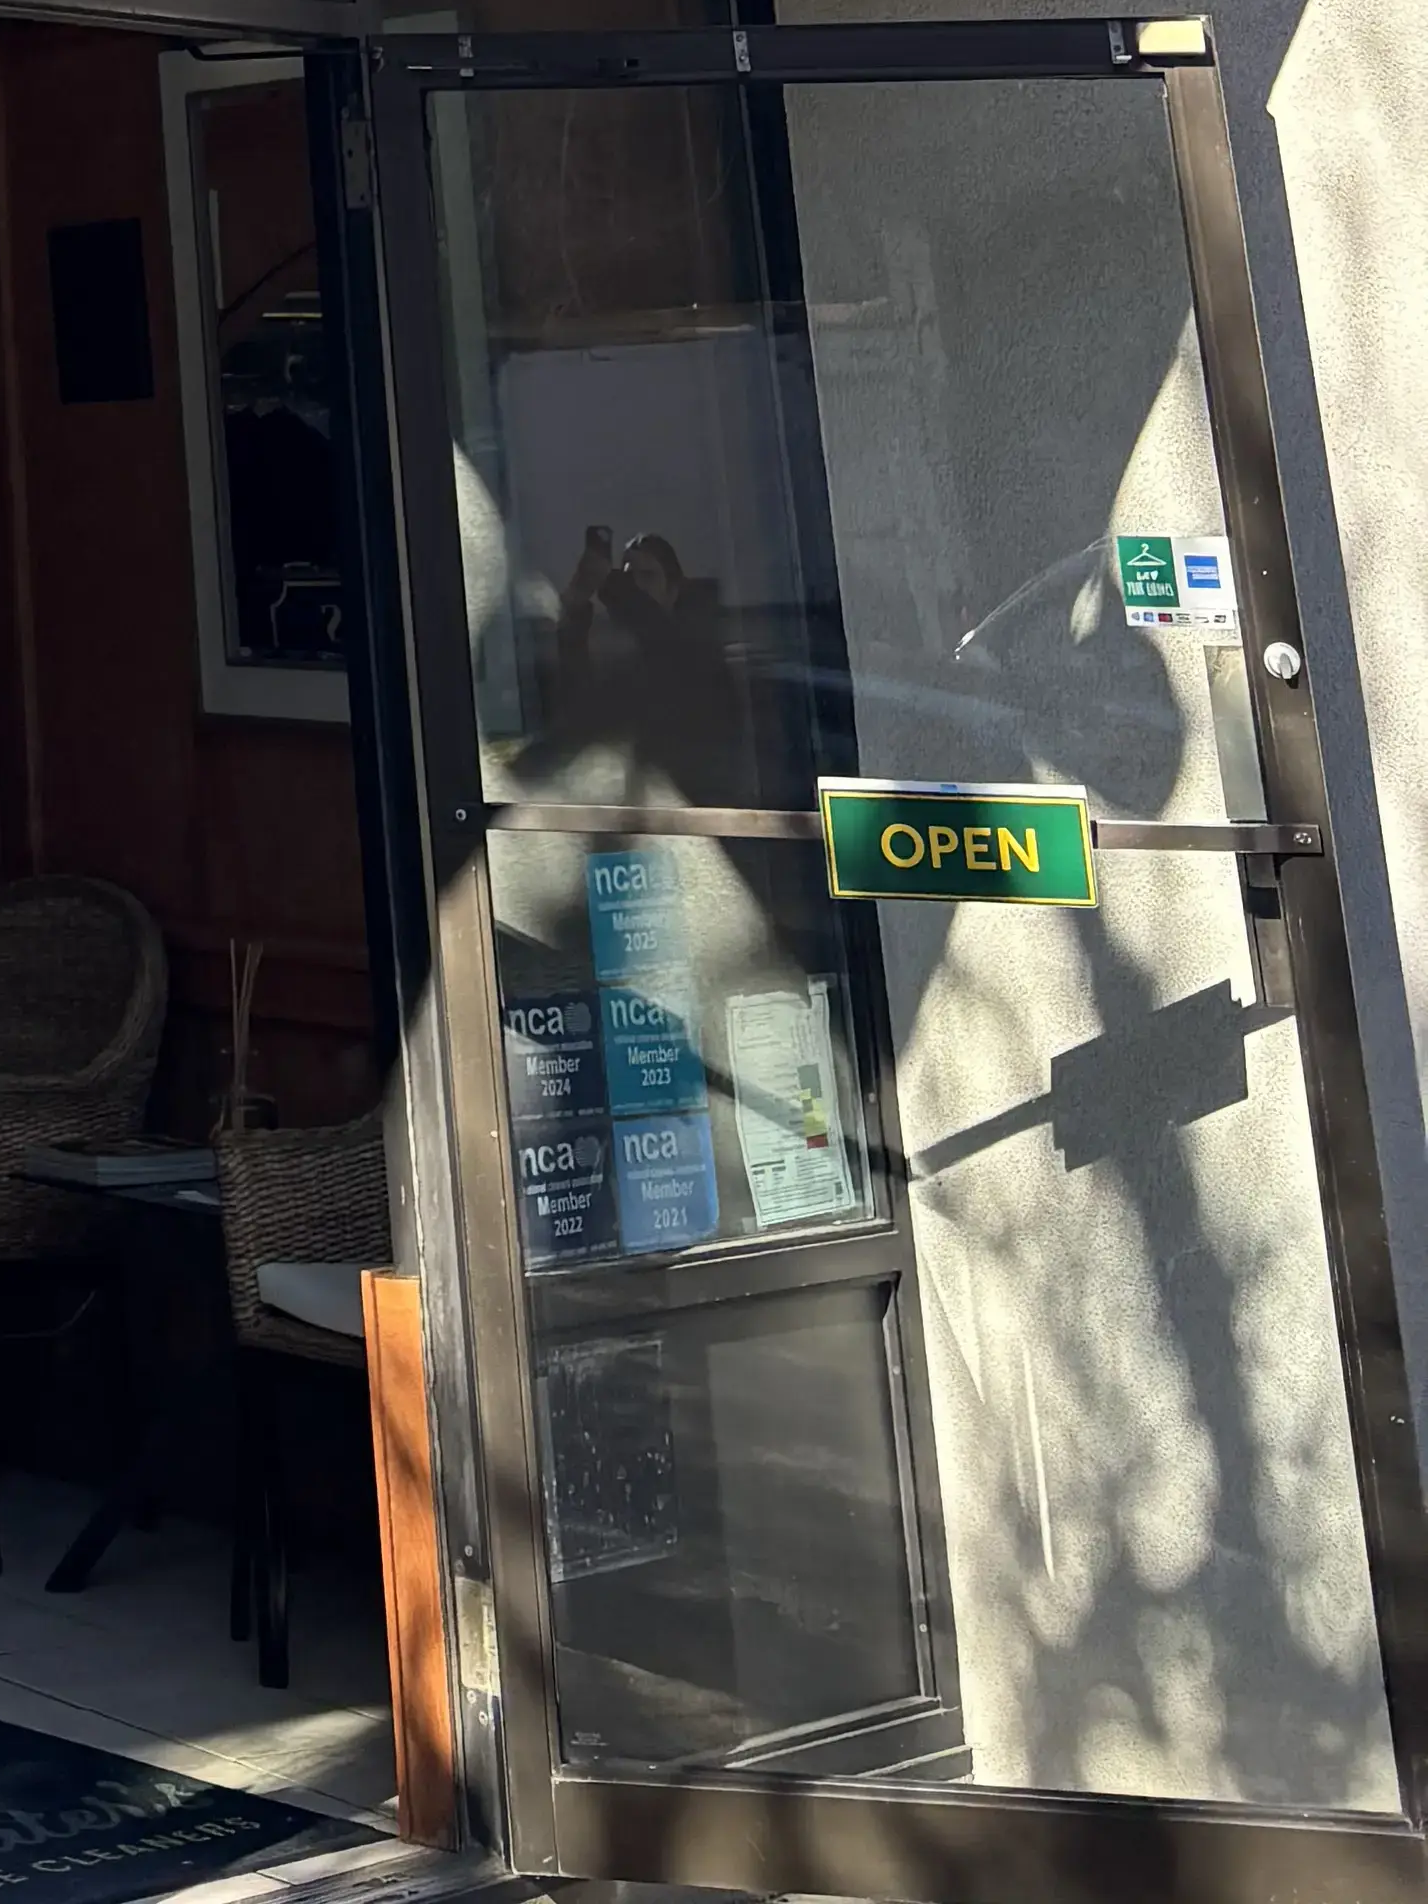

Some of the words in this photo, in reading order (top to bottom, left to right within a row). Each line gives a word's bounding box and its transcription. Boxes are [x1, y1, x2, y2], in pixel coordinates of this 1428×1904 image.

[880, 823, 1041, 873] OPEN
[594, 863, 648, 896] nca
[623, 931, 658, 952] 2025
[508, 1006, 565, 1036] nca
[609, 997, 666, 1030] nca
[526, 1055, 581, 1076] Member
[627, 1044, 680, 1067] Member
[541, 1079, 572, 1098] 2024
[641, 1067, 672, 1087] 2023
[518, 1141, 576, 1178] nca
[623, 1130, 680, 1165] nca
[640, 1178, 695, 1202] Member
[537, 1191, 593, 1217] Member
[554, 1215, 584, 1238] 2022
[652, 1207, 688, 1231] 2021
[31, 1815, 261, 1873] CLEANERS
